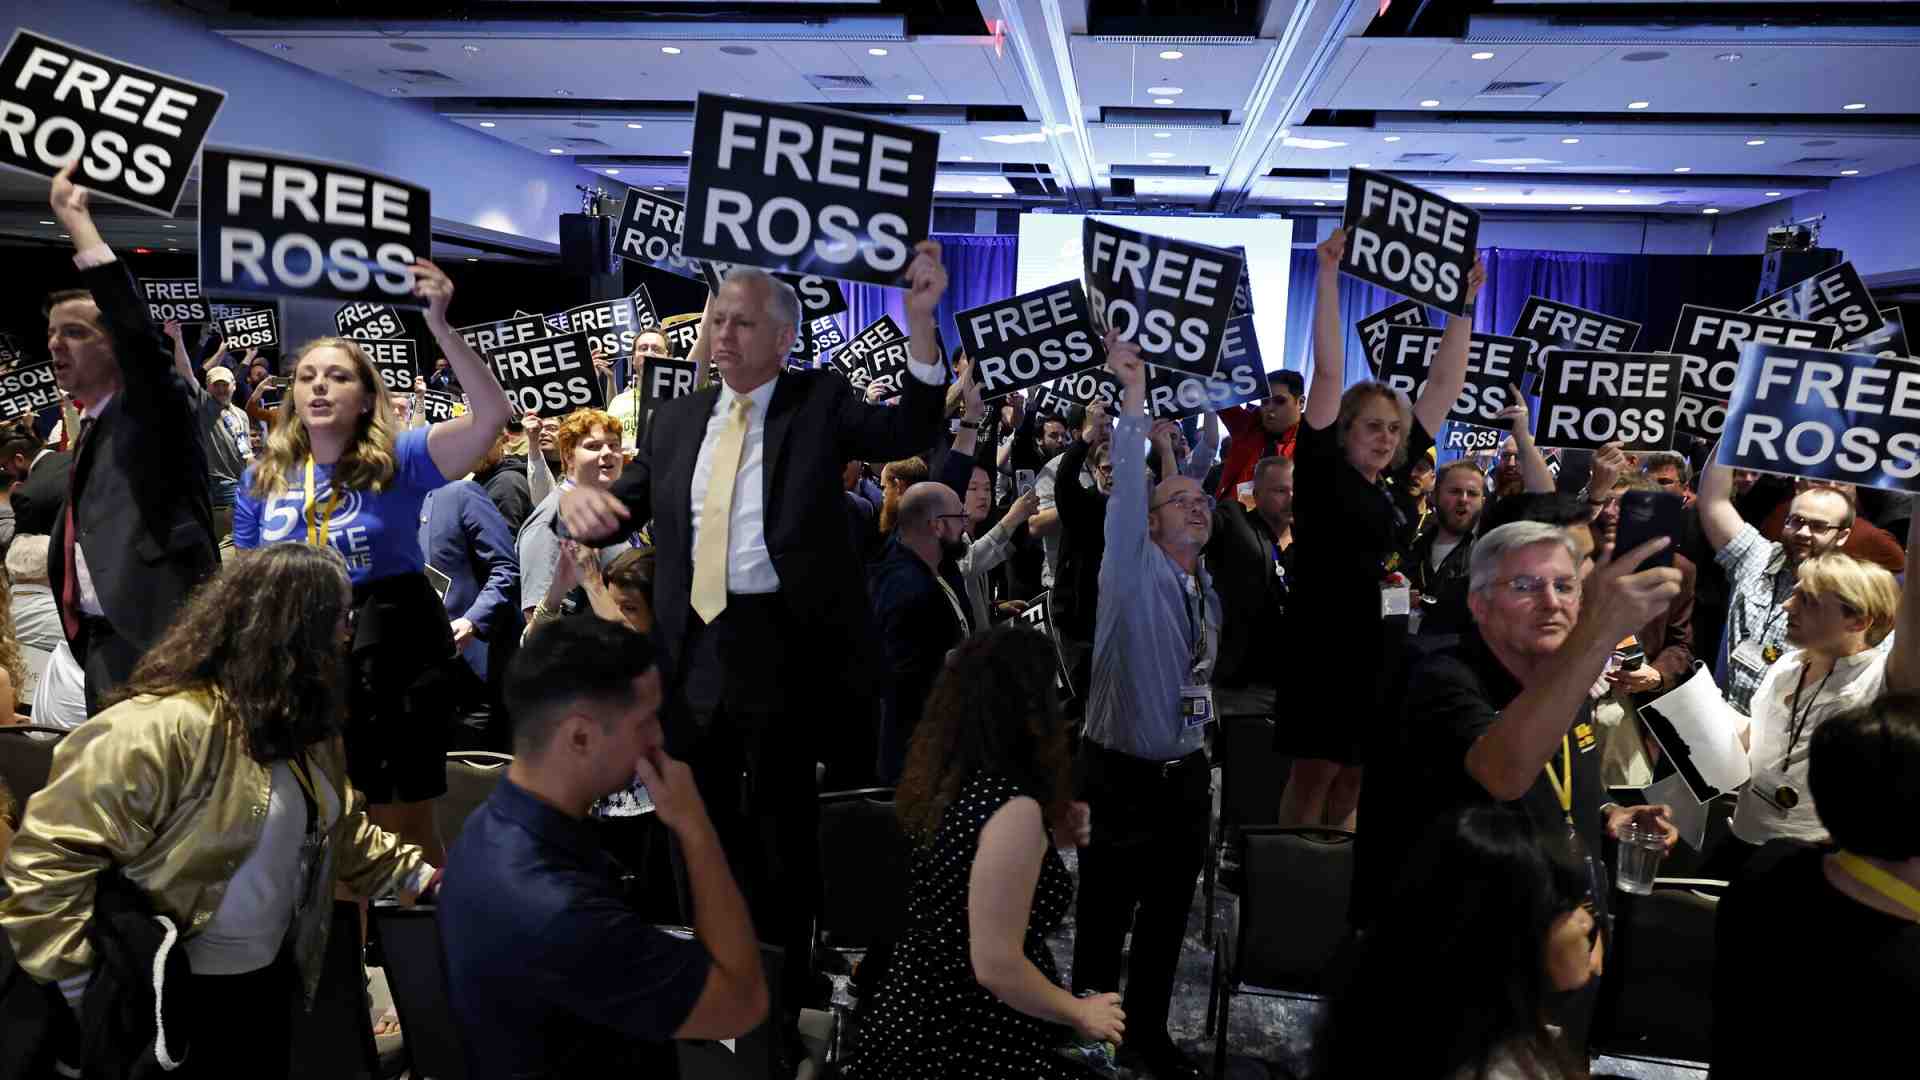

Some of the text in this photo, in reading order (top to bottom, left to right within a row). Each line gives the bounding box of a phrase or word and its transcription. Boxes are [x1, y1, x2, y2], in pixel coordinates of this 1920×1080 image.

[15, 47, 198, 138] FREE
[0, 103, 172, 196] ROSS
[717, 111, 912, 197] FREE
[226, 160, 411, 235] FREE
[1361, 179, 1469, 254] FREE
[702, 187, 909, 272] ROSS
[220, 227, 417, 295] ROSS
[1091, 231, 1223, 307] FREE
[1350, 227, 1462, 302] ROSS
[145, 283, 199, 299] FREE
[149, 303, 205, 320] ROSS
[225, 314, 270, 334] FREE
[549, 315, 570, 330] EE
[572, 304, 629, 332] FREE
[810, 315, 834, 334] EE
[969, 289, 1078, 350] FREE
[1089, 285, 1210, 363] ROSS
[1527, 305, 1626, 352] FREE
[227, 330, 273, 349] ROSS
[587, 331, 634, 355] OSS
[668, 324, 700, 349] FR
[812, 330, 841, 353] OSS
[840, 322, 894, 369] FREE
[1689, 315, 1817, 352] FREE
[360, 344, 409, 364] REE
[494, 340, 581, 382] FREE
[873, 342, 908, 371] FR
[979, 330, 1094, 391] ROSS
[1681, 354, 1740, 392] RO
[381, 369, 412, 388] SS
[504, 377, 592, 415] ROSS
[651, 366, 693, 399] FR
[1150, 365, 1257, 417] ROSS
[1558, 359, 1672, 398] FREE
[1755, 356, 1920, 420] FREE
[0, 385, 62, 416] FREE
[1040, 391, 1073, 418] FR
[1675, 396, 1727, 434] RO
[1450, 430, 1498, 448] ROSS
[1548, 405, 1665, 443] ROSS
[1736, 413, 1920, 479] ROSS
